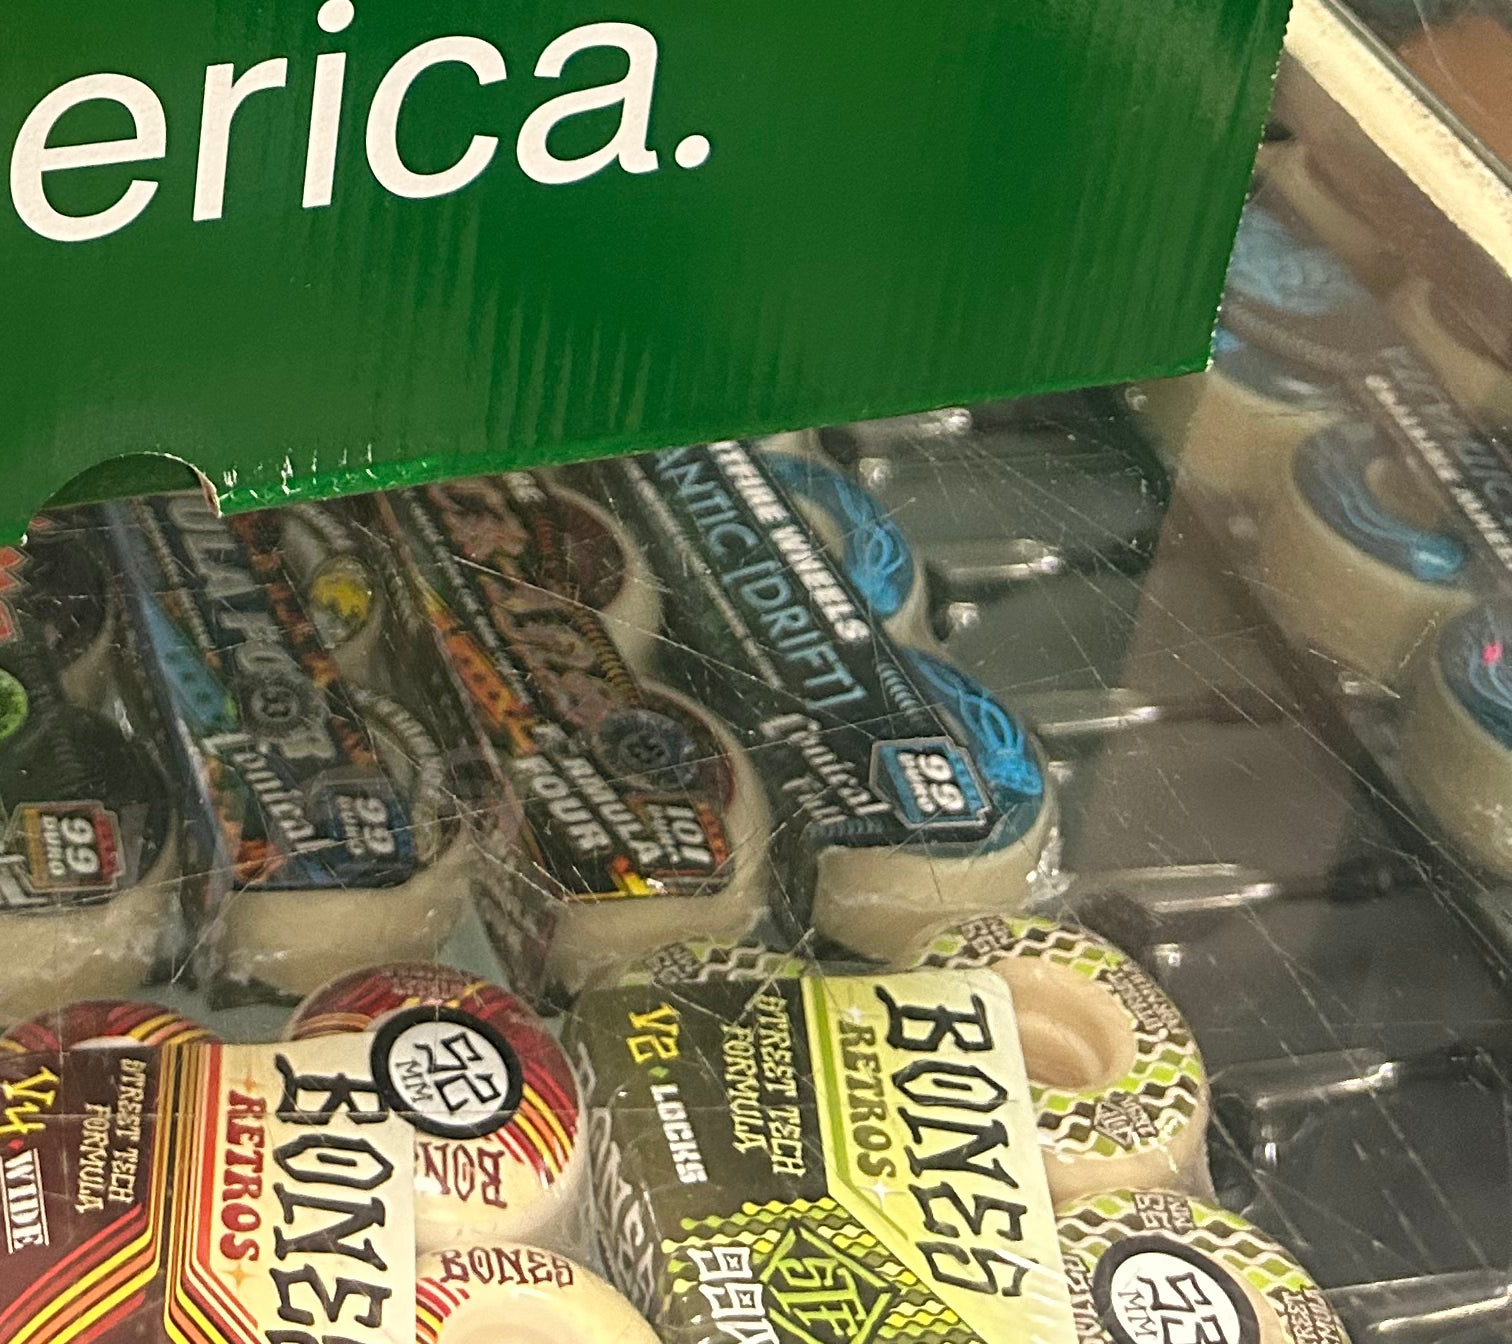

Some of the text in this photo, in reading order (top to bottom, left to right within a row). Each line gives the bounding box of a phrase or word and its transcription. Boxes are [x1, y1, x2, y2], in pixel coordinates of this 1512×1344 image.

[510, 754, 613, 857] FOUR
[914, 749, 967, 814] 99
[60, 817, 101, 876] 99
[394, 1058, 434, 1105] MM
[414, 1030, 504, 1114] 52
[626, 1001, 681, 1066] V2
[108, 1056, 148, 1205] STREET TECH
[649, 1082, 710, 1185] LOCKS
[719, 1021, 769, 1156] FORMULA
[754, 993, 808, 1179] STREET TECH
[838, 1018, 898, 1181] RETROS
[74, 1102, 112, 1214] FORMULA
[218, 1088, 268, 1263] RETROS
[416, 1140, 509, 1210] BON
[874, 984, 1039, 1299] BONES
[2, 1149, 44, 1250] WIDE
[433, 1244, 575, 1289] BONES
[776, 1254, 867, 1338] STF
[1118, 1288, 1159, 1340] MM
